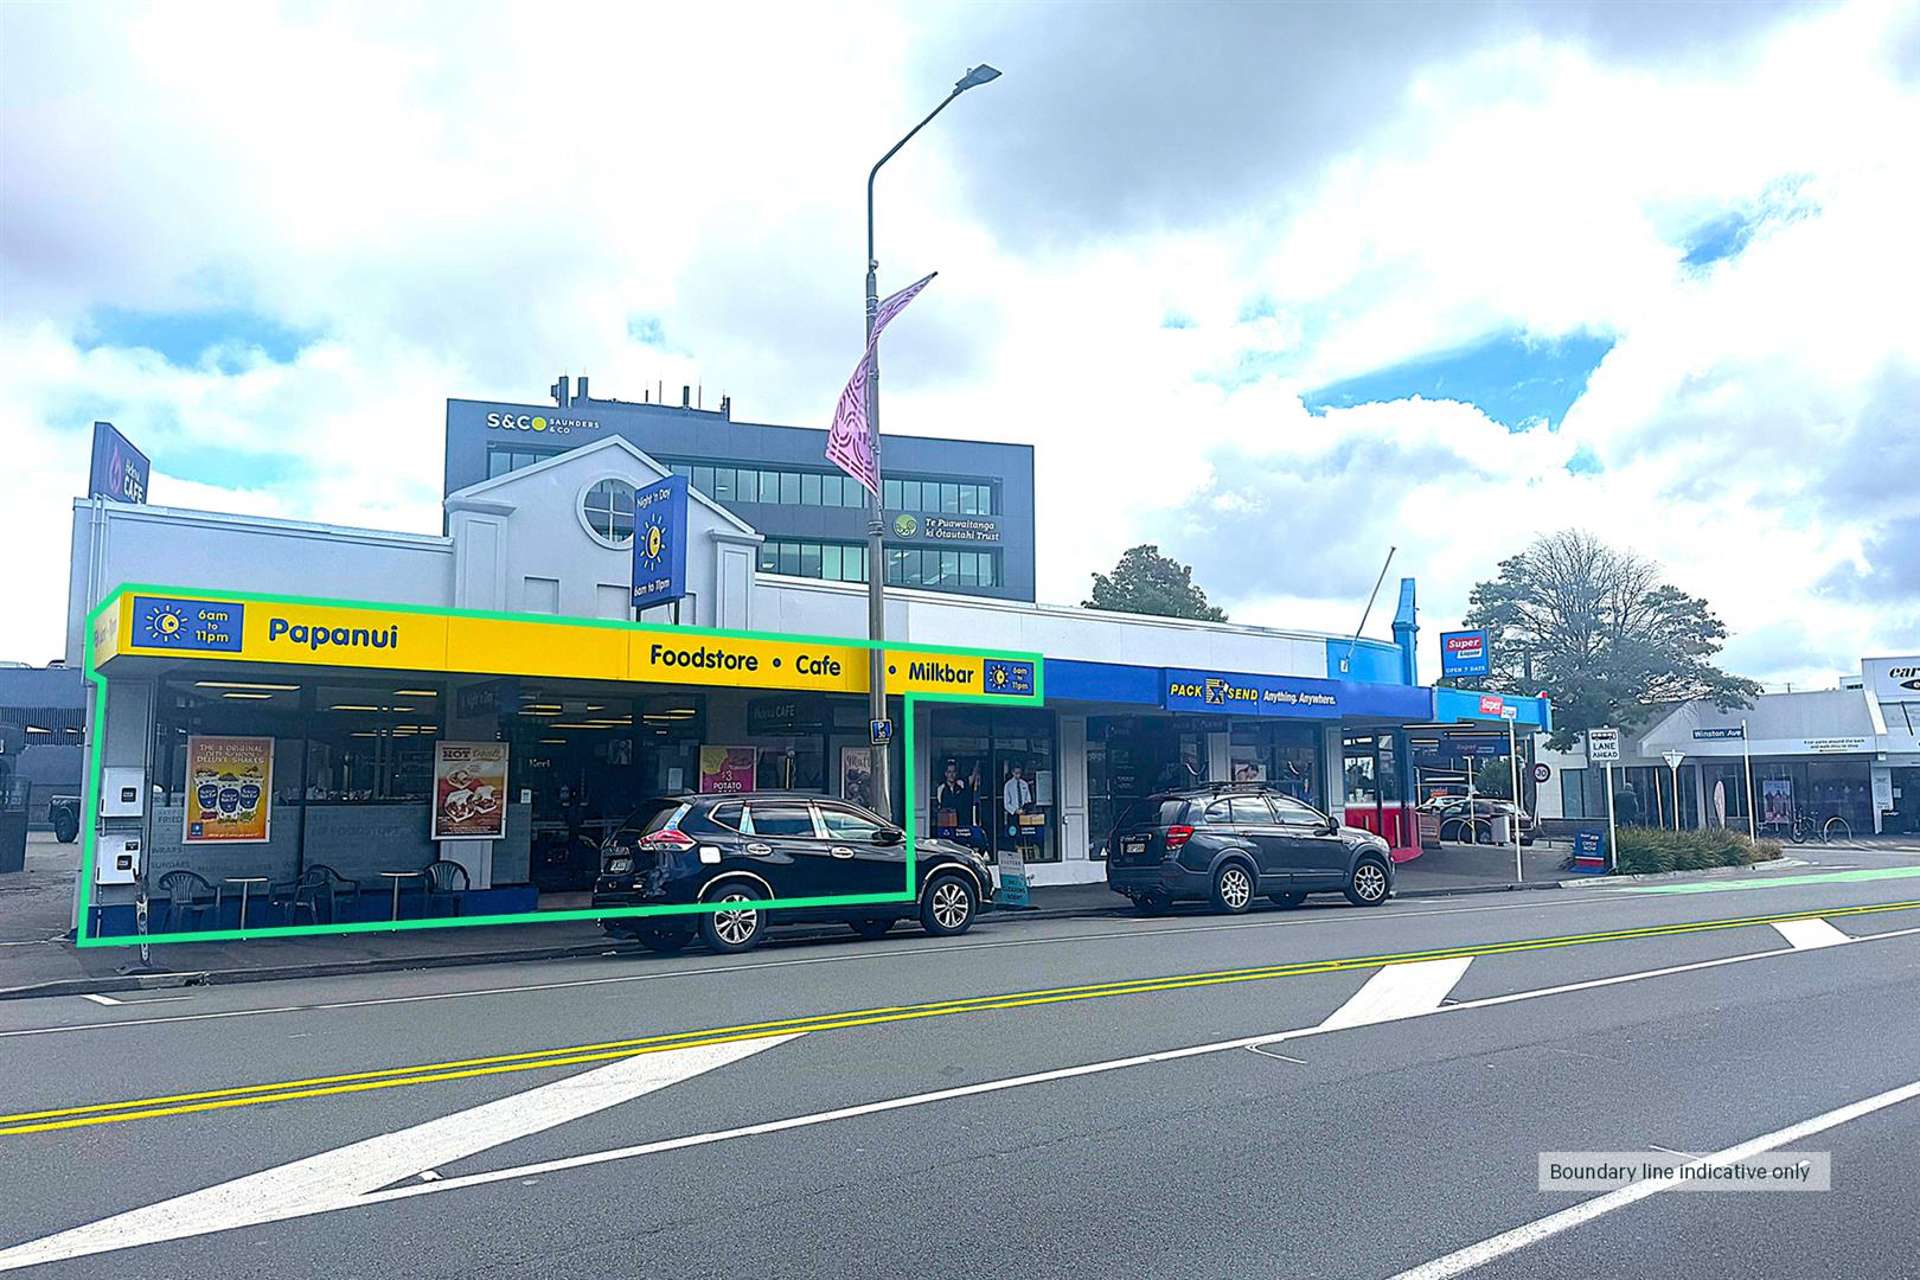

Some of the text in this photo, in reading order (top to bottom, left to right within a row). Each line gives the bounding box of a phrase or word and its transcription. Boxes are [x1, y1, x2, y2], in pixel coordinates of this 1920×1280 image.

[549, 418, 600, 429] SAUNDERS
[925, 518, 935, 527] Te
[976, 532, 999, 541] Trust
[198, 609, 229, 622] 6am
[207, 622, 218, 631] to
[195, 630, 229, 644] 11pm
[269, 617, 398, 651] Papanui
[1448, 638, 1480, 649] Super
[650, 643, 975, 684] Foodstore Cafe Milkbar
[1170, 683, 1203, 698] PACK
[1227, 688, 1259, 701] SEND
[1694, 729, 1742, 739] Winston Ave
[1593, 742, 1616, 750] LANE
[712, 782, 742, 790] POTATO
